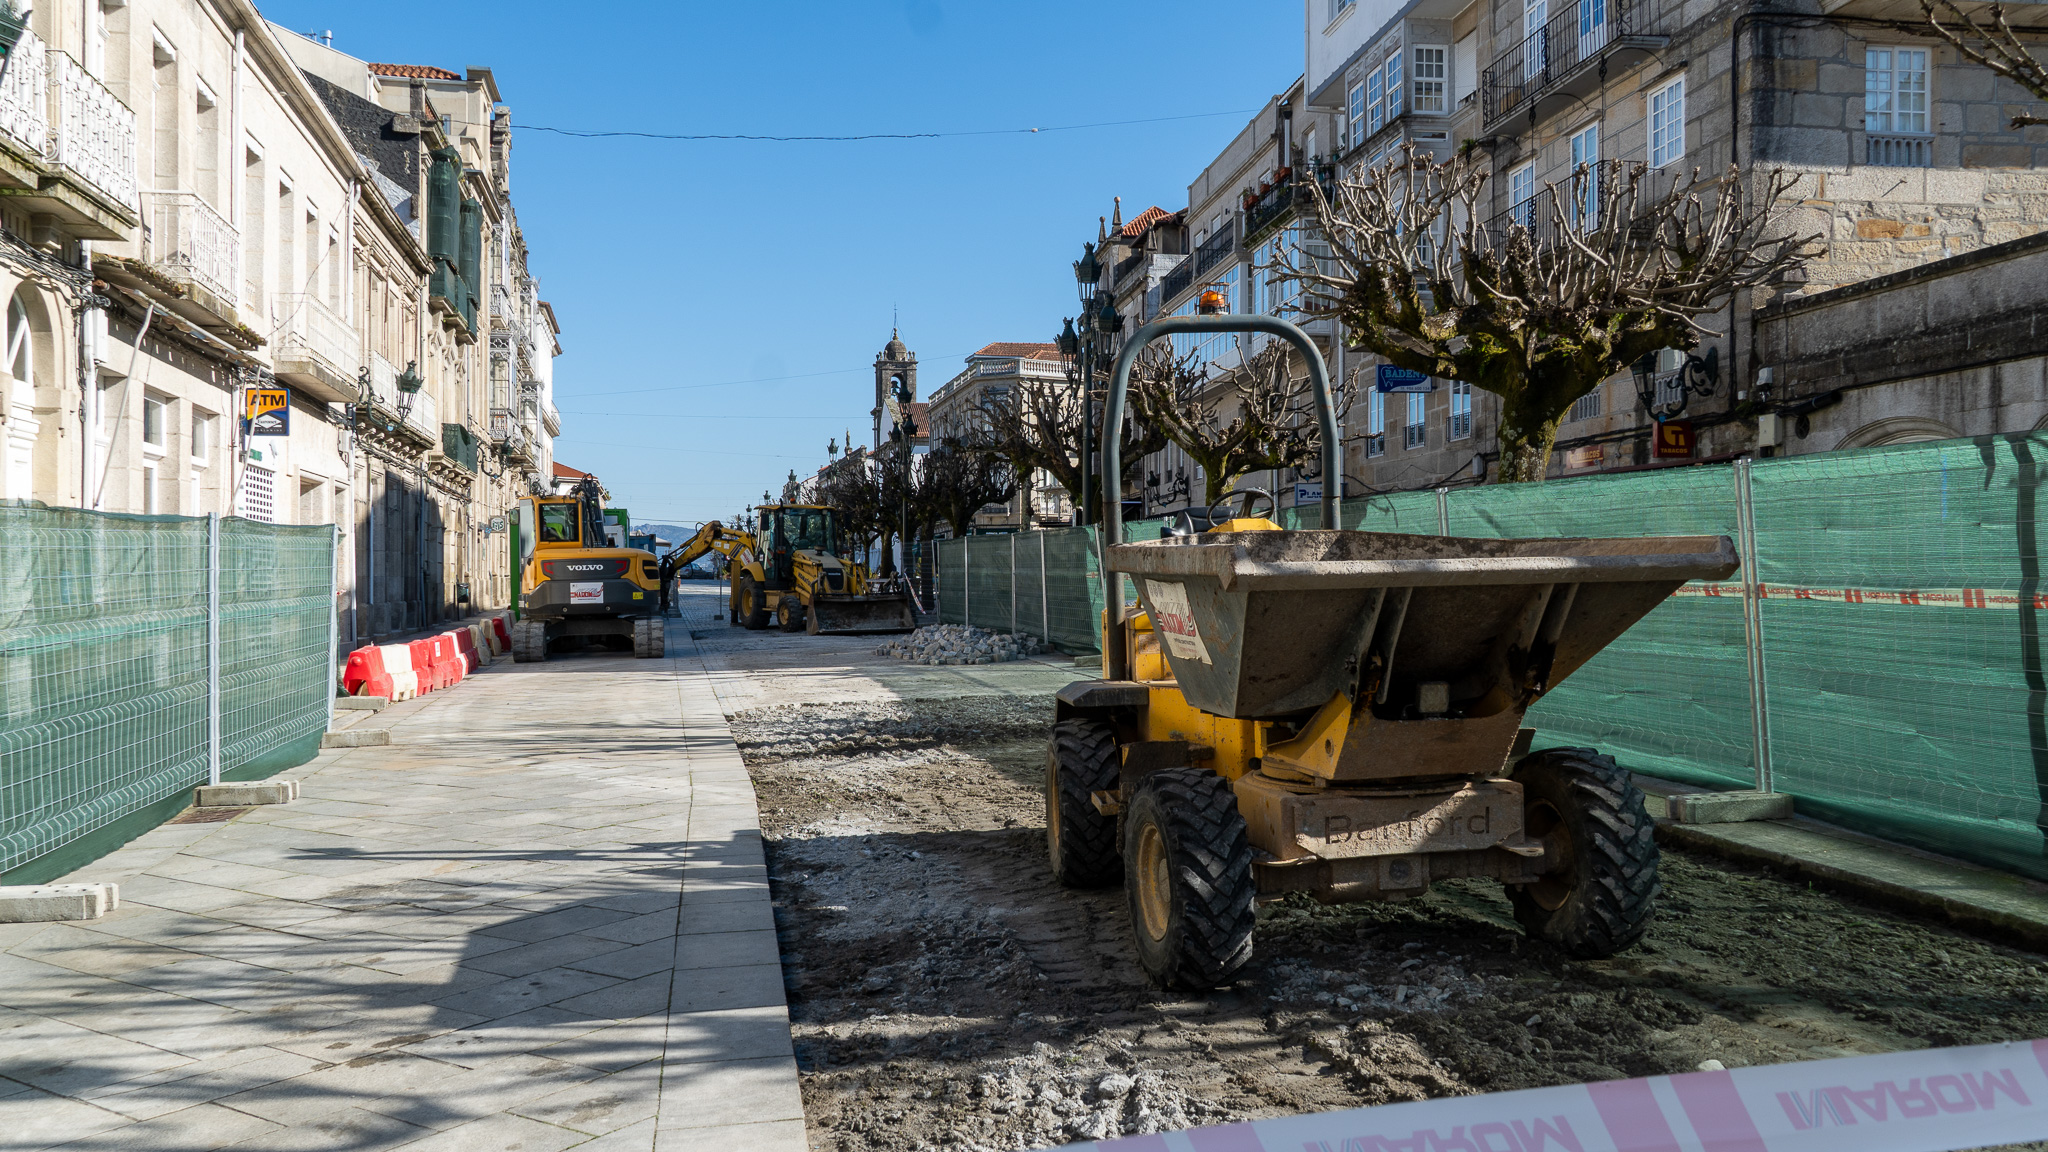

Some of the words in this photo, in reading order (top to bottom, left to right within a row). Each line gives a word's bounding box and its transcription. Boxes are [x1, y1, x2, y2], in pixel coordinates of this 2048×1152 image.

[250, 394, 285, 406] ATM
[1576, 449, 1601, 461] TABACOS
[1324, 806, 1491, 845] Barford
